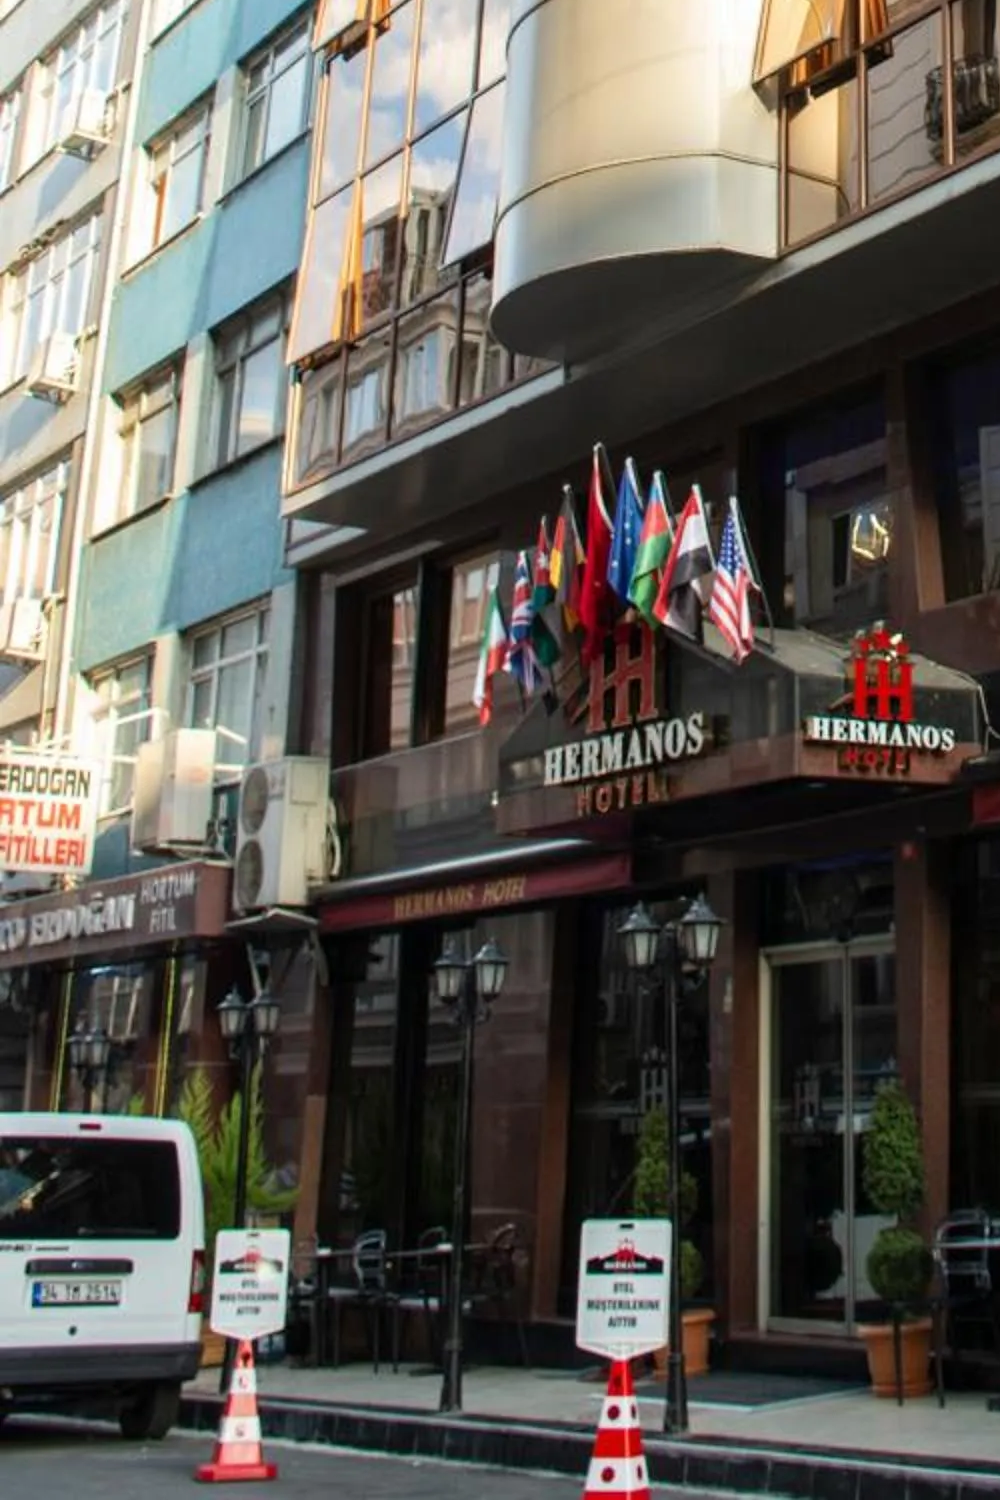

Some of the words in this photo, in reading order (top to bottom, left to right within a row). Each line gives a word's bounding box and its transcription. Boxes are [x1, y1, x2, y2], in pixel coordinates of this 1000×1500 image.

[544, 711, 704, 786] HERMANOS
[811, 716, 955, 751] HERMANOS
[576, 769, 668, 817] HOTEL
[482, 874, 527, 906] HOTEL
